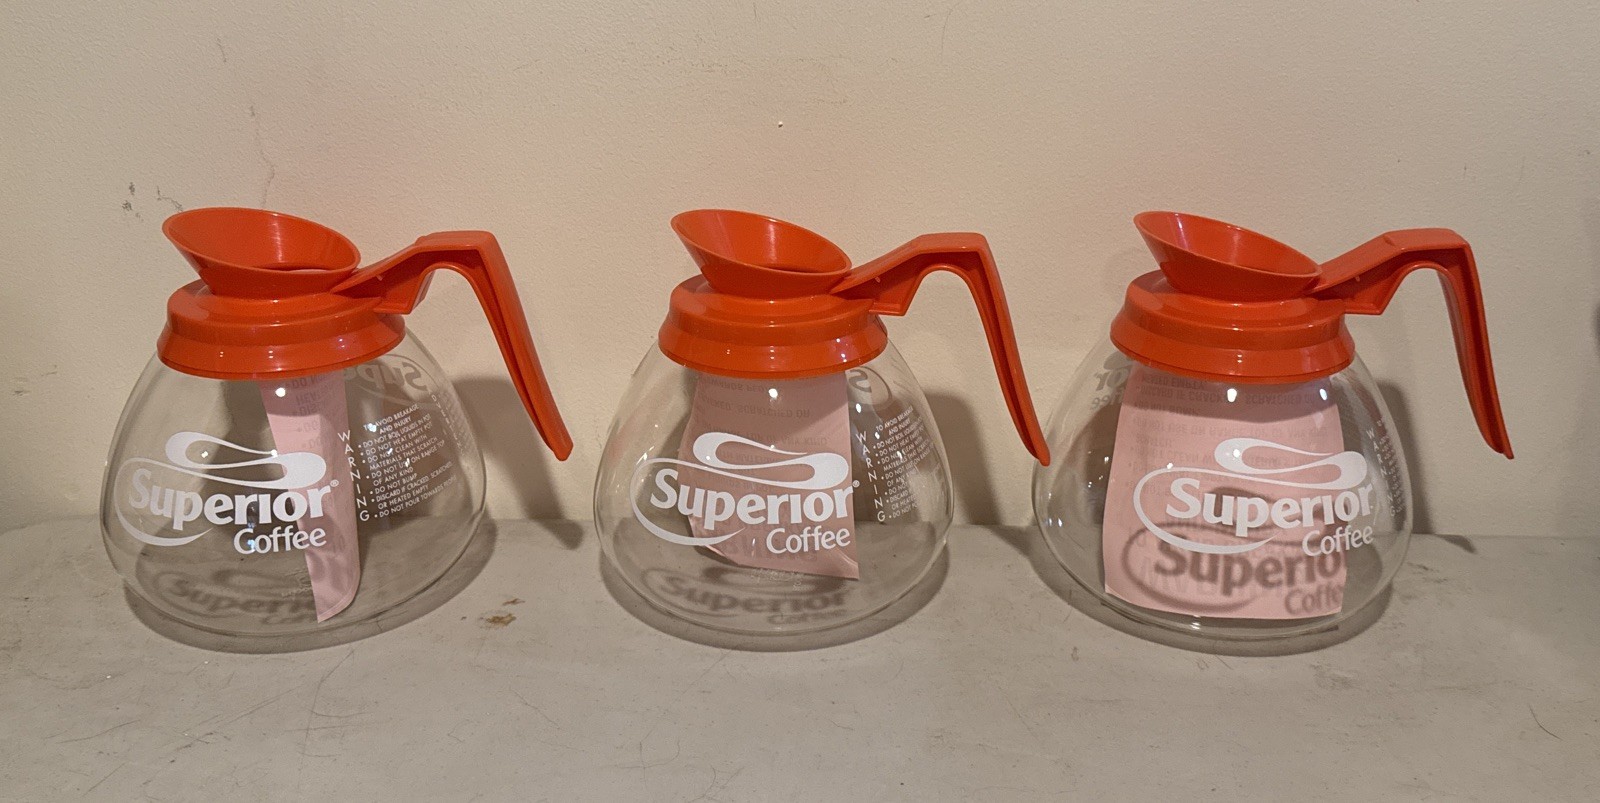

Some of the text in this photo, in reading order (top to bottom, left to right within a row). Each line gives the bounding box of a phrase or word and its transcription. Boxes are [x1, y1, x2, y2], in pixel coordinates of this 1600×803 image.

[394, 404, 419, 420] BREAKAGE
[380, 416, 411, 434] AND INJURY
[889, 427, 898, 436] AND
[368, 455, 378, 463] DO
[395, 442, 413, 453] CLEAN
[415, 434, 427, 443] WITH
[375, 436, 387, 444] NOT
[378, 443, 391, 451] NOT
[393, 436, 407, 445] HEAT
[408, 428, 423, 439] EMPTY
[886, 436, 895, 445] NOT
[889, 444, 899, 453] NOT
[370, 437, 438, 470] MATERIALS THAT SCRATCH
[384, 465, 397, 474] NOT
[385, 474, 398, 482] ANY
[400, 467, 413, 476] KIND
[894, 466, 904, 475] NOT
[375, 473, 418, 495] DO NOT BUMP
[889, 487, 897, 495] DO
[128, 468, 332, 531] Superior
[376, 489, 400, 502] DISCARD
[389, 494, 411, 506] HEATED
[412, 485, 429, 495] EMPTY
[650, 468, 854, 531] Superior
[380, 510, 389, 518] DO
[391, 502, 404, 513] NOT
[406, 497, 420, 508] POUR
[1165, 478, 1373, 537] Superior
[233, 526, 326, 554] Coffee
[766, 525, 851, 554] Coffee
[1302, 524, 1375, 556] Coffee
